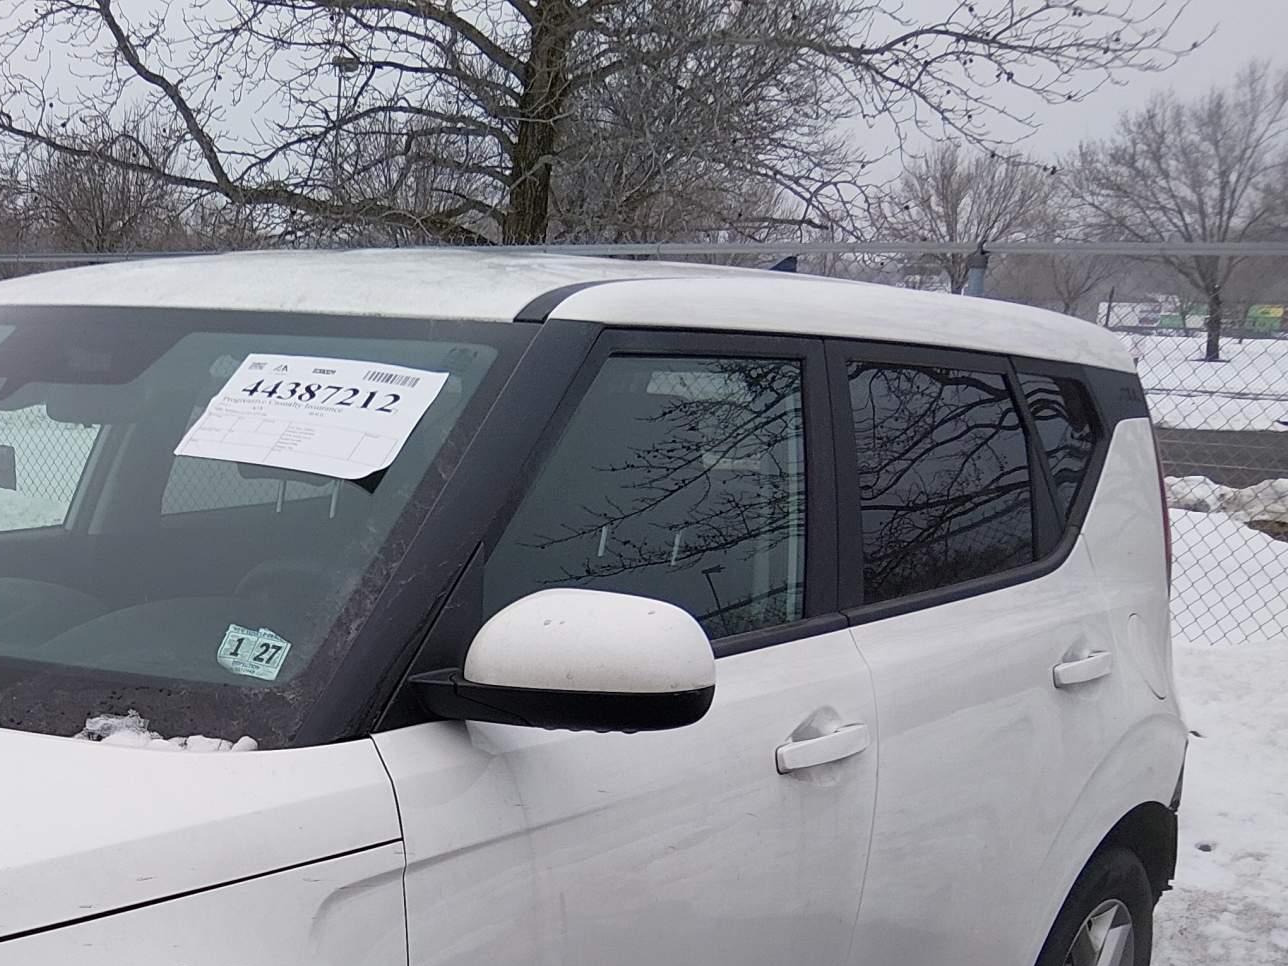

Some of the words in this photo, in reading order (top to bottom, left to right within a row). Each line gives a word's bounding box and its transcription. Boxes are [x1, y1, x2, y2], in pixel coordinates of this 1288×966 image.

[242, 378, 402, 413] 44387212
[303, 402, 343, 413] Insurance
[229, 637, 245, 657] 1
[253, 642, 282, 665] 27
